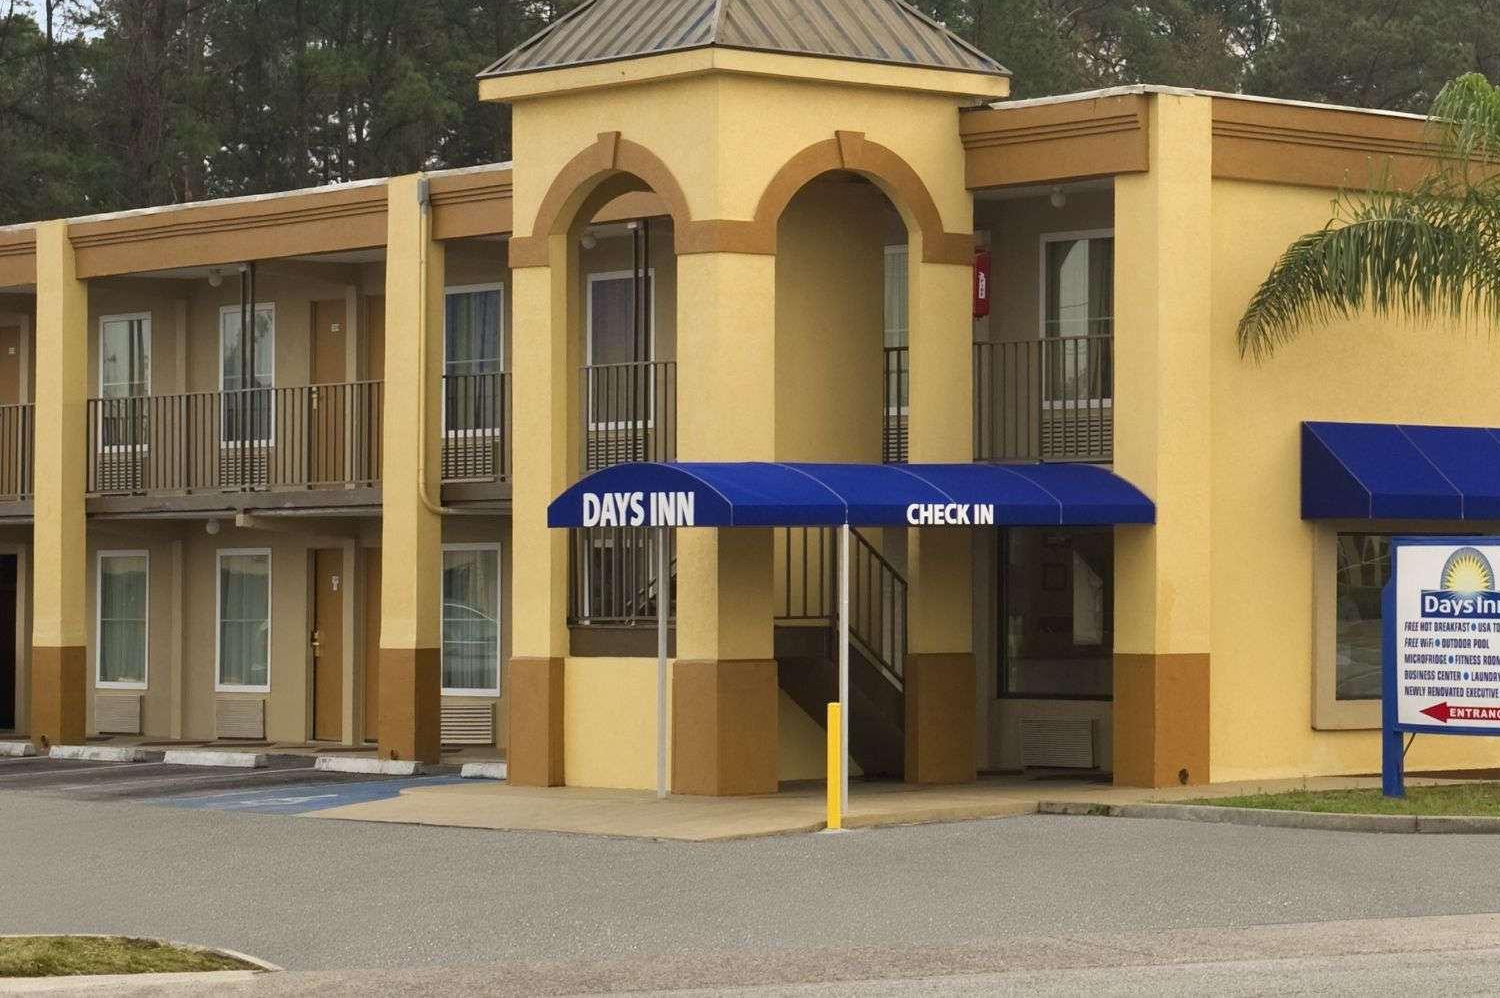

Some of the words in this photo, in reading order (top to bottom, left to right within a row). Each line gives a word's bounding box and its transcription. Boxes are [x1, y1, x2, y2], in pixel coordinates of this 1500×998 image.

[583, 491, 645, 527] DAYS
[650, 491, 695, 527] INN
[906, 503, 971, 525] CHECK
[974, 504, 994, 525] IN
[1424, 595, 1474, 616] Days
[1404, 621, 1419, 632] FREE
[1420, 621, 1432, 632] HOT
[1434, 622, 1470, 633] BREAKFAST
[1477, 622, 1491, 633] USA
[1404, 637, 1419, 648] FREE
[1441, 638, 1472, 649] OUTDOOR
[1473, 639, 1490, 649] POOL
[1404, 654, 1447, 665] MICROFRIDGE
[1455, 655, 1481, 665] FITNESS
[1404, 670, 1436, 681] BUSINESS
[1437, 670, 1461, 681] CENTER
[1471, 671, 1500, 682] LAUNDRY
[1404, 686, 1425, 697] NEWLY
[1427, 686, 1464, 698] RENOVATED
[1466, 687, 1499, 699] EXECUTIVE
